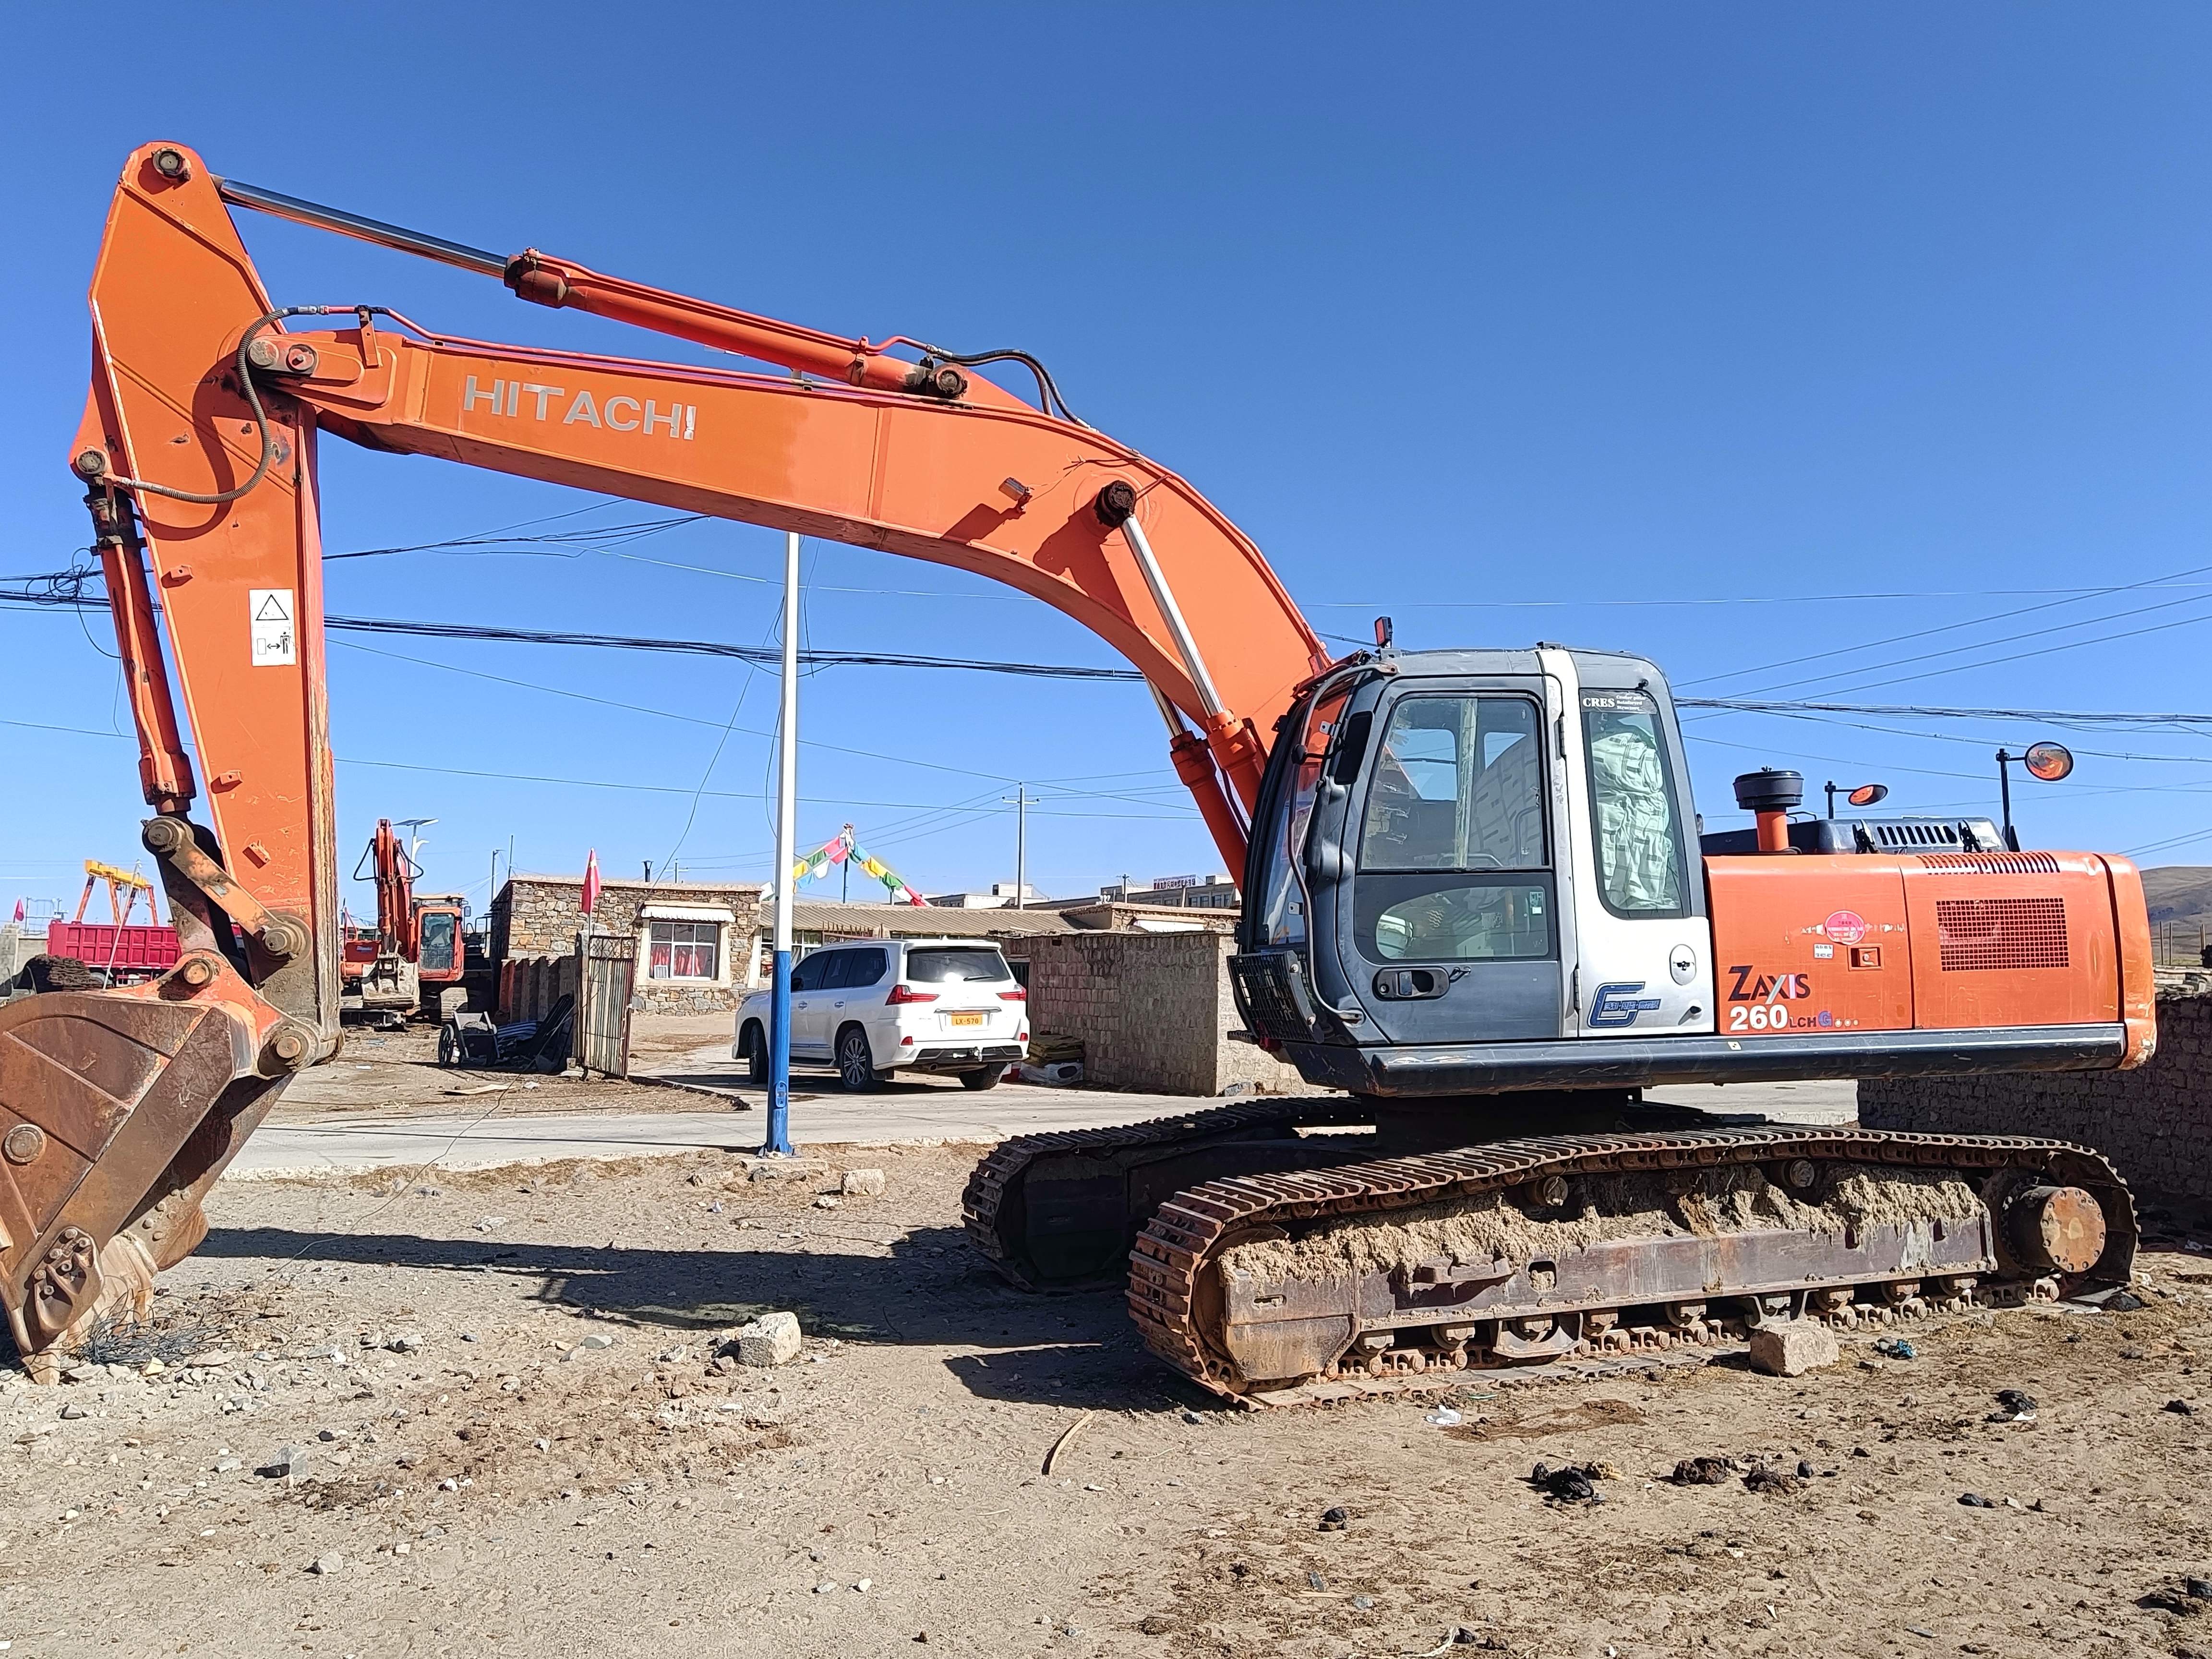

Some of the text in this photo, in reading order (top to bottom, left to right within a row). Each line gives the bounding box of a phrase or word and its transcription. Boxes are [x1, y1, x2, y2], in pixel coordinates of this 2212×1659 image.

[464, 375, 697, 440] HITACHI
[1583, 697, 1615, 708] CRES
[1728, 965, 1811, 1005] ZAXIS
[1730, 1004, 1788, 1031] 260
